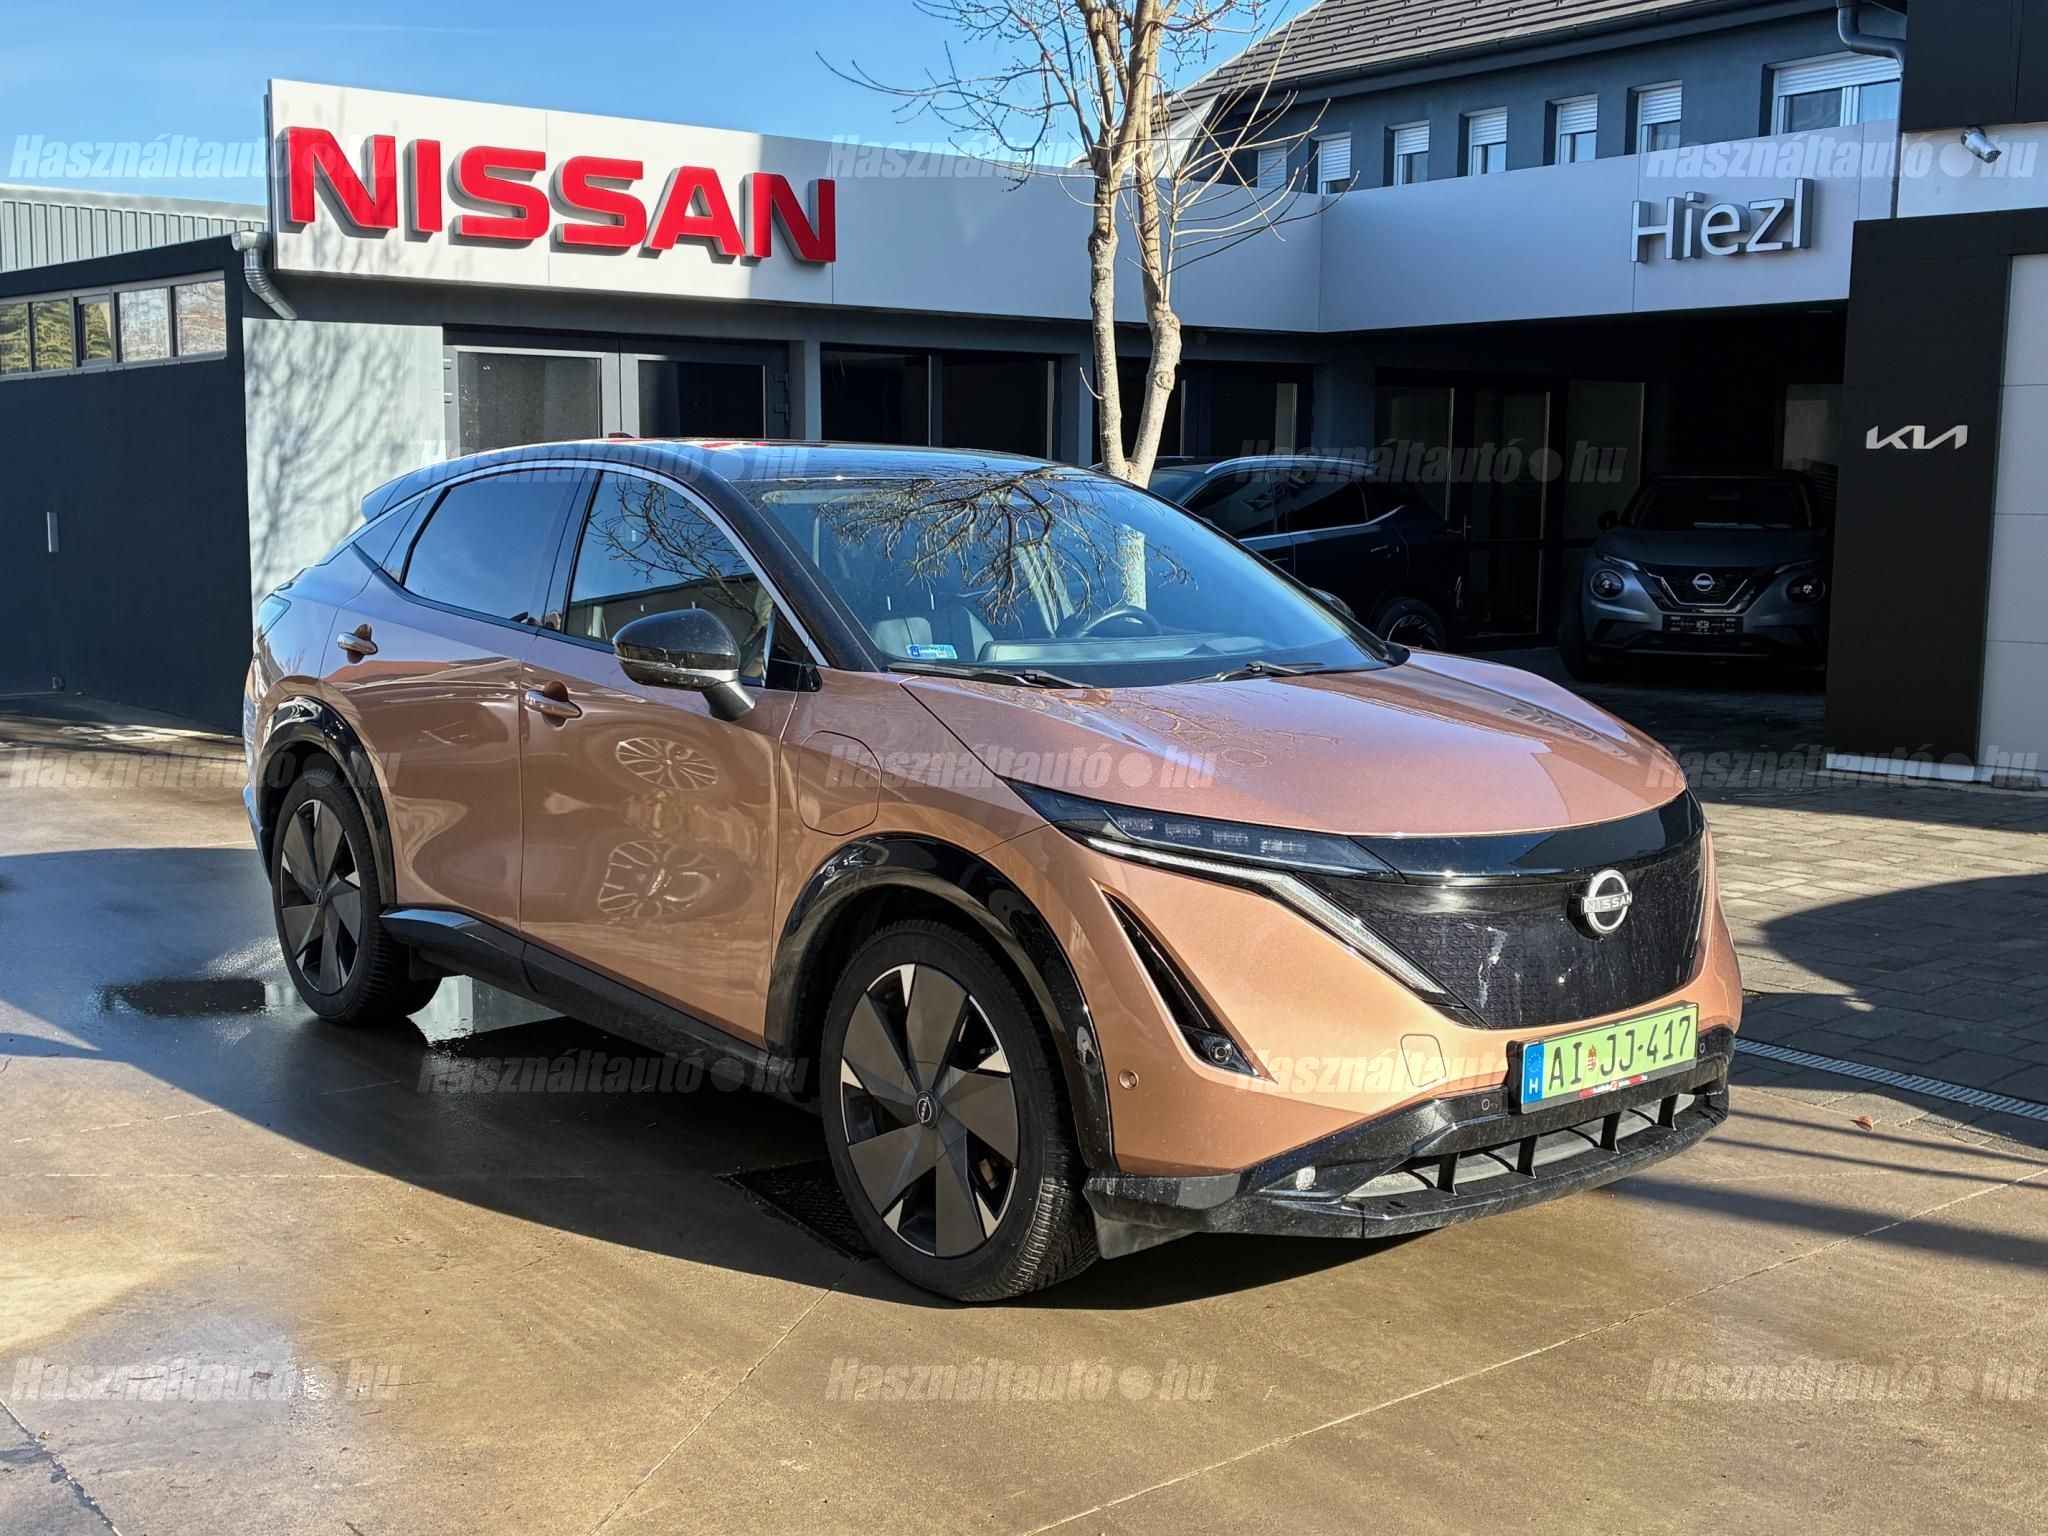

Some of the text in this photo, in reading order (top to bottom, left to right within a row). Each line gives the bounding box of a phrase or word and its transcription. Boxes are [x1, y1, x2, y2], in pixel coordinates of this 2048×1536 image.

[285, 127, 835, 263] NISSAN
[1632, 178, 1813, 263] Hiezl
[1866, 425, 1968, 449] KIA
[1586, 892, 1632, 912] NISSAN
[1528, 1078, 1539, 1094] H
[1549, 1042, 1582, 1091] AI
[1600, 1015, 1691, 1077] JJ-417
